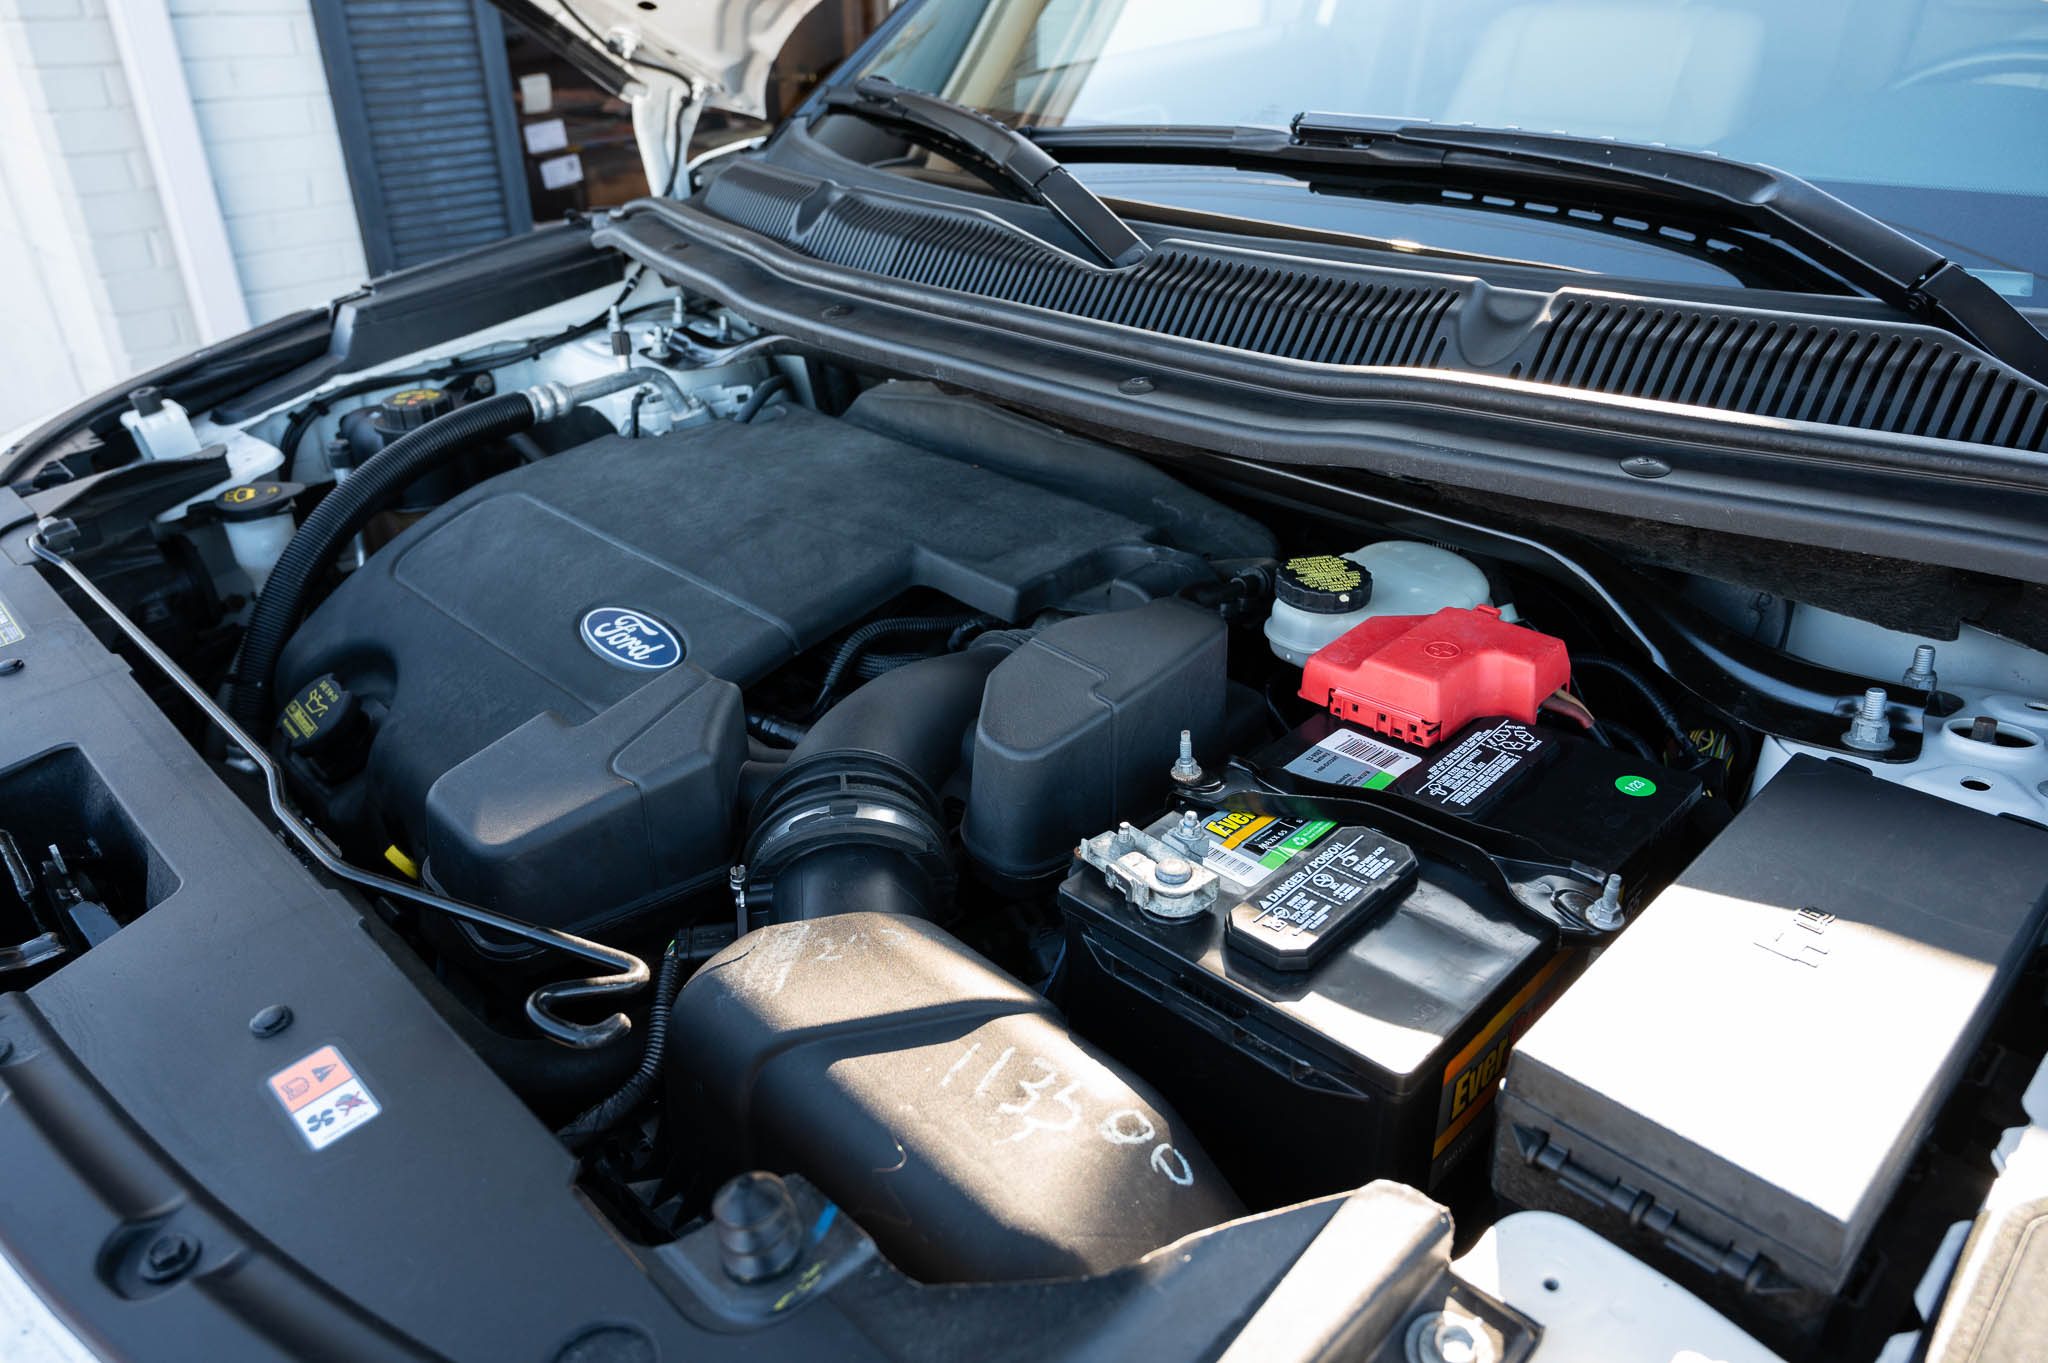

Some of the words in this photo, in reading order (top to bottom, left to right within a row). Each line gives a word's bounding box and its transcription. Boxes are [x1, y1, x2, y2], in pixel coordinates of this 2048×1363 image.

[594, 615, 665, 660] Ford
[1266, 871, 1309, 902] DANGER
[1308, 842, 1346, 869] POISON
[1452, 1036, 1508, 1121] Ever
